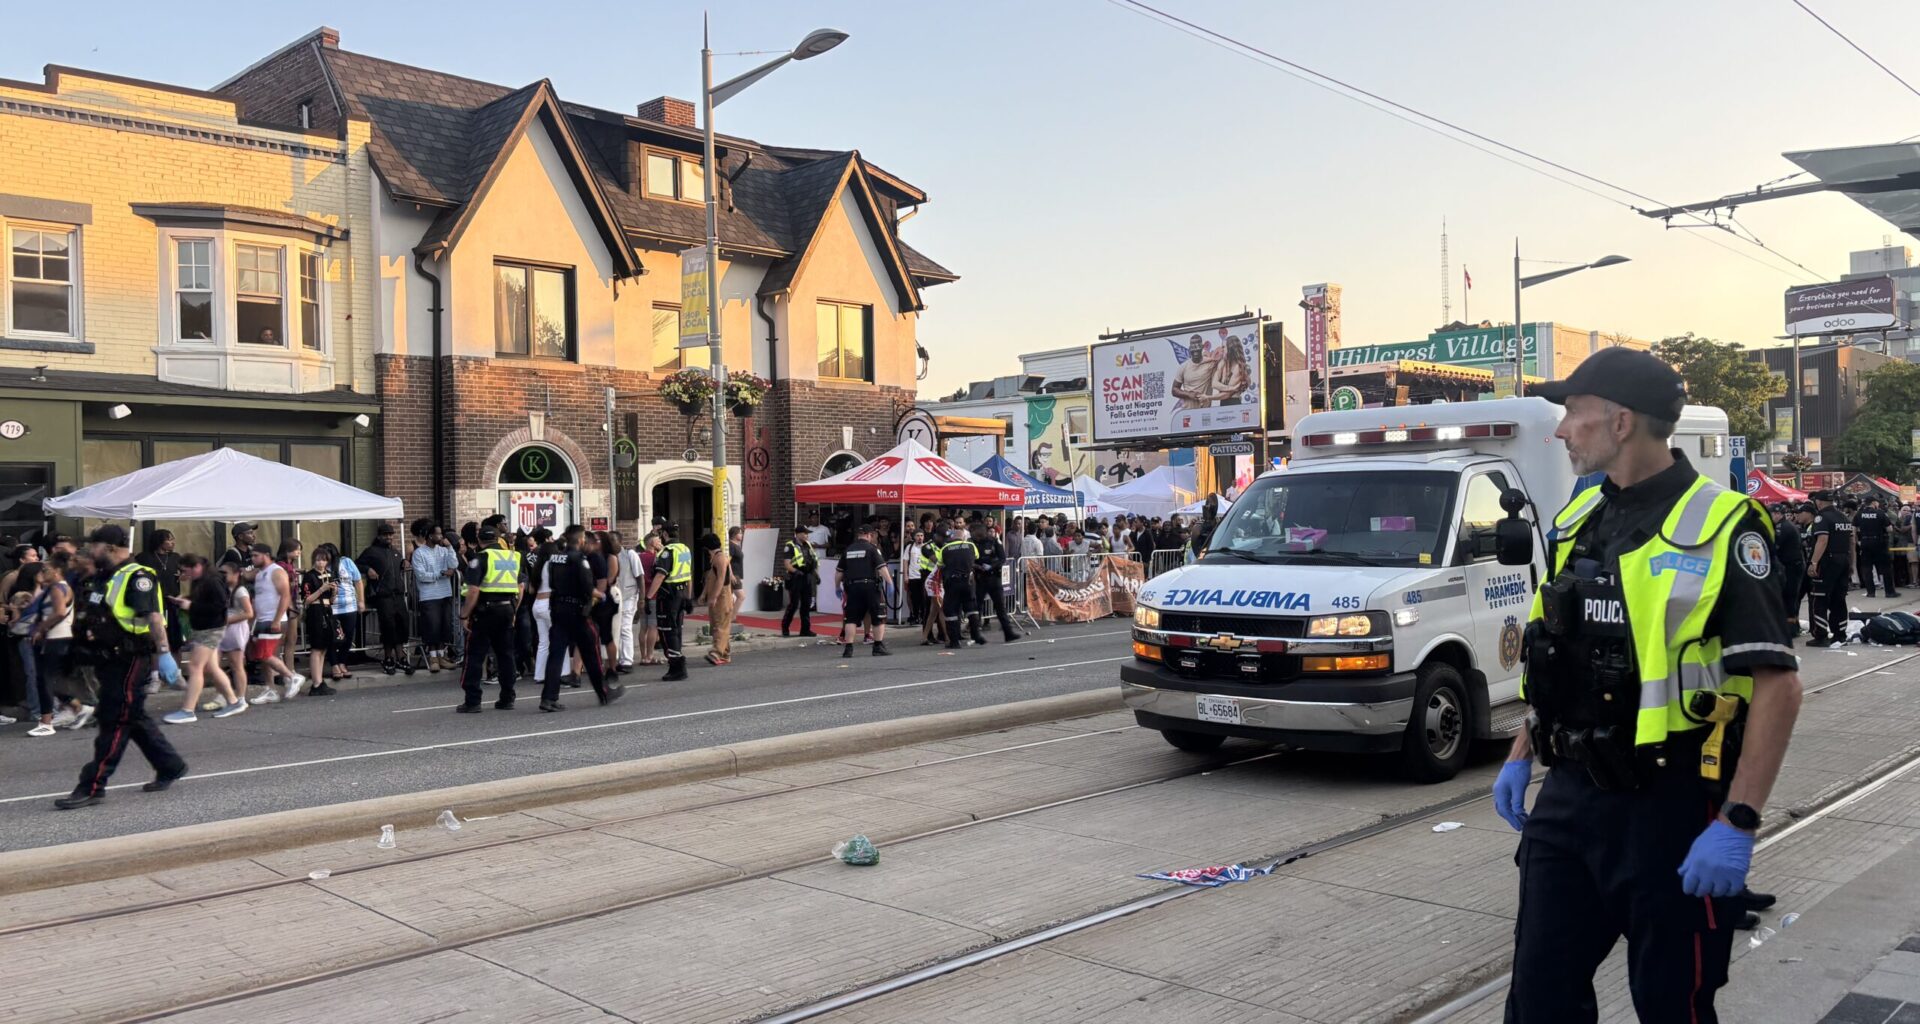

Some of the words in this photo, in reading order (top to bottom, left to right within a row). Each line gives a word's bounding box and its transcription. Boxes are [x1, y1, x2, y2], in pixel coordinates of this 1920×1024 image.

[1798, 292, 1837, 303] Everything
[1852, 287, 1868, 296] need
[1869, 286, 1880, 295] for
[1788, 306, 1804, 314] your
[1806, 302, 1835, 310] business
[1860, 296, 1891, 305] software
[1823, 317, 1856, 329] odoo
[1336, 342, 1437, 367] Hillcrest
[1445, 334, 1535, 360] Village
[1115, 351, 1150, 368] SALSA
[1103, 374, 1143, 392] SCAN
[1103, 393, 1119, 404] TO
[1121, 389, 1143, 402] WIN
[1338, 396, 1349, 409] P
[1105, 404, 1124, 412] Salsa
[1134, 400, 1163, 410] Niagara
[1110, 411, 1126, 419] Falls
[1126, 409, 1158, 418] Getaway
[5, 424, 21, 435] 779
[1211, 444, 1251, 455] PATTISON
[528, 455, 542, 474] K
[752, 452, 763, 467] K
[876, 489, 899, 499] tln.ca
[998, 491, 1020, 502] tln.ca
[519, 505, 535, 527] tln
[539, 509, 553, 517] VIP
[550, 554, 568, 563] POLICE
[1487, 573, 1521, 586] TORONTO
[1406, 590, 1423, 605] 485
[1484, 581, 1527, 601] PARAMEDIC
[1331, 596, 1360, 609] 485
[1489, 595, 1524, 610] SERVICES
[1198, 702, 1208, 715] BL
